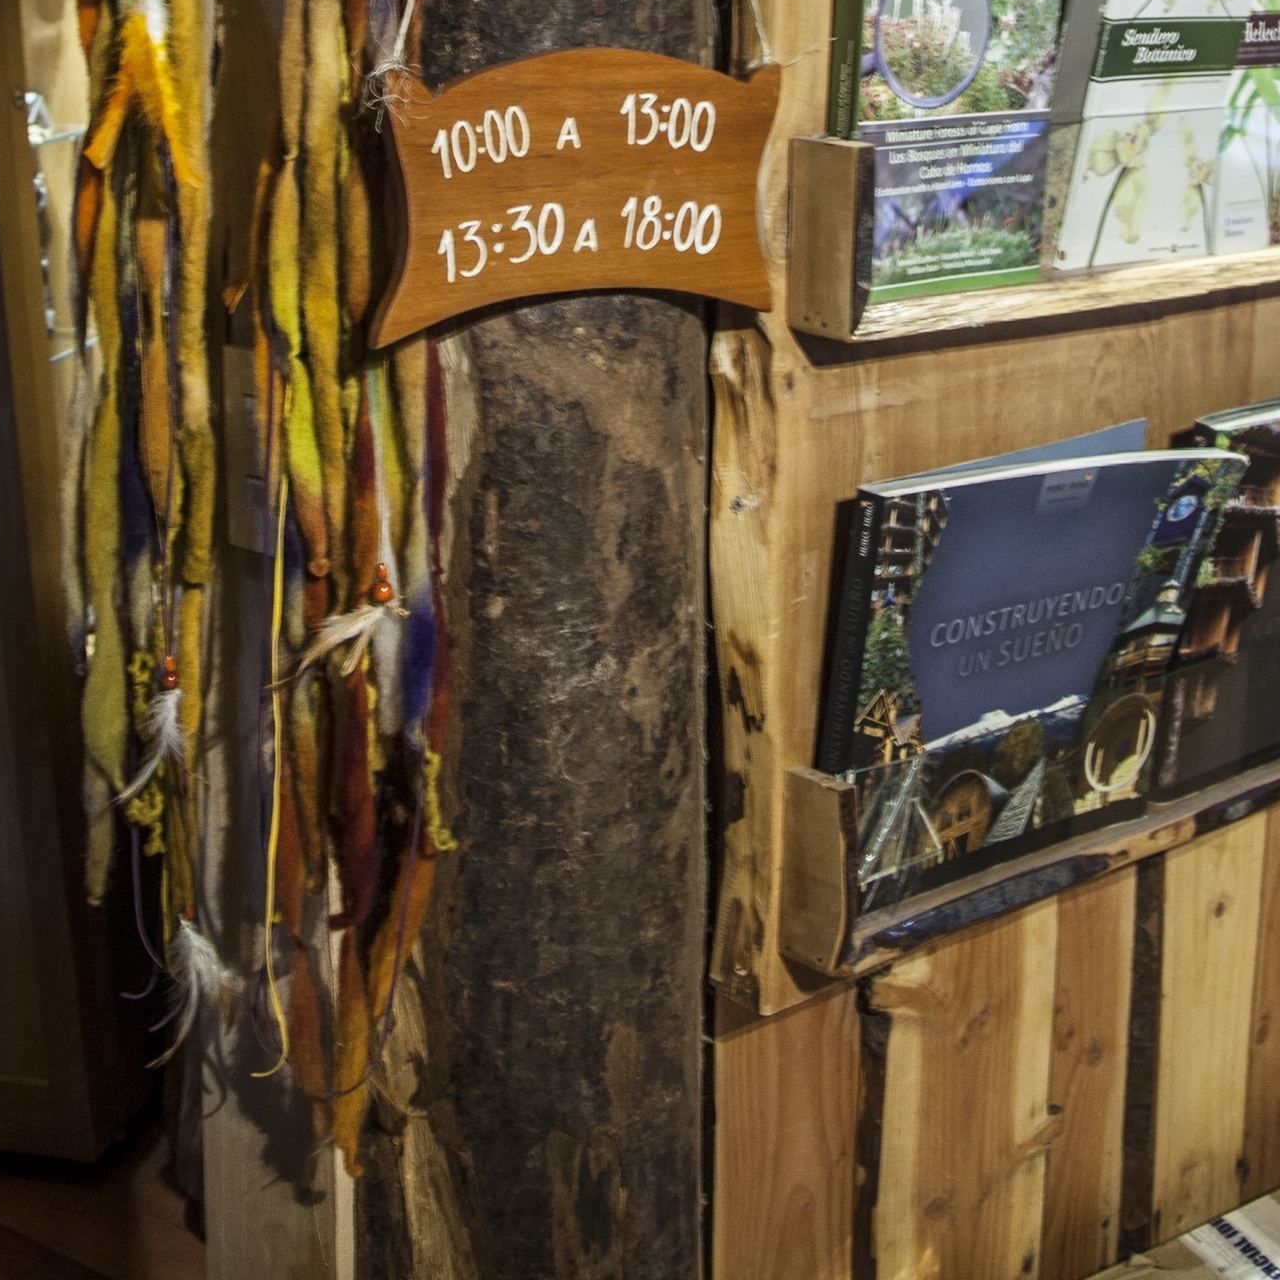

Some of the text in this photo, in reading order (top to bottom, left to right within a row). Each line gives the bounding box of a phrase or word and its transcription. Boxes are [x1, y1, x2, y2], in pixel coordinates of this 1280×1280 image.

[1121, 28, 1180, 48] Sendero
[1133, 43, 1197, 65] Botánico
[431, 93, 716, 179] 10:00 A 13:00
[437, 195, 722, 283] 13:30 A 18:00
[930, 582, 1127, 648] CONSTRUYENDO
[958, 622, 1084, 677] UN SUEÑO
